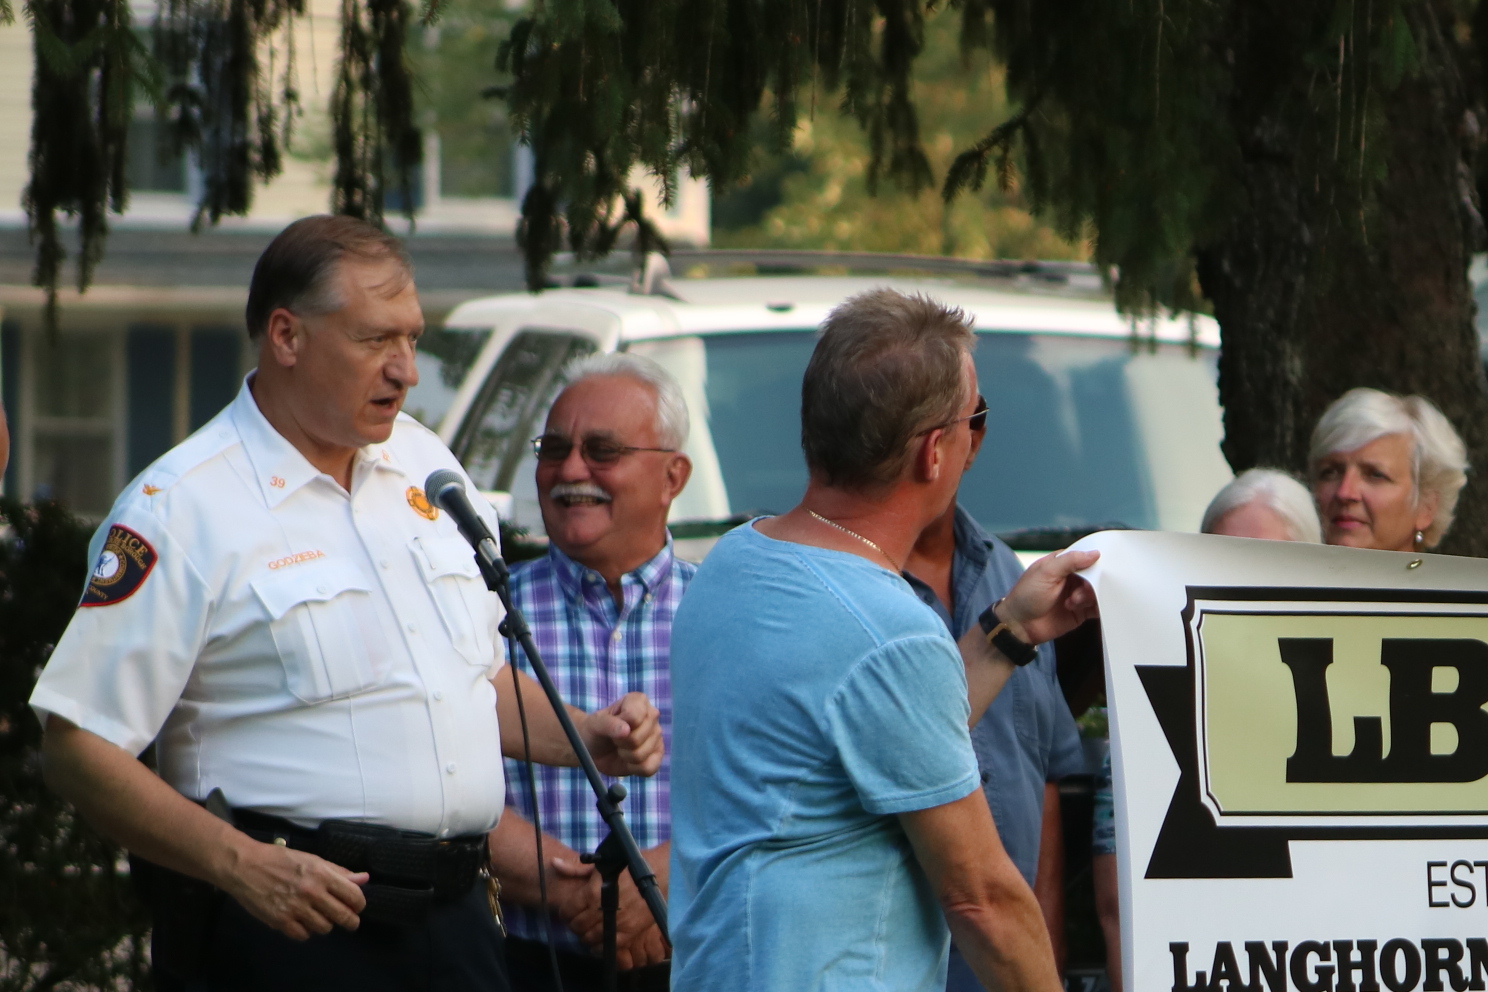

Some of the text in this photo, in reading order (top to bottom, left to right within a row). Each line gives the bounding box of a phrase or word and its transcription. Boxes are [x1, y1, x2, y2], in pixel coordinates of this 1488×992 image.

[270, 476, 286, 488] 39
[109, 528, 148, 557] OLICE
[268, 549, 326, 570] GODZIEBA
